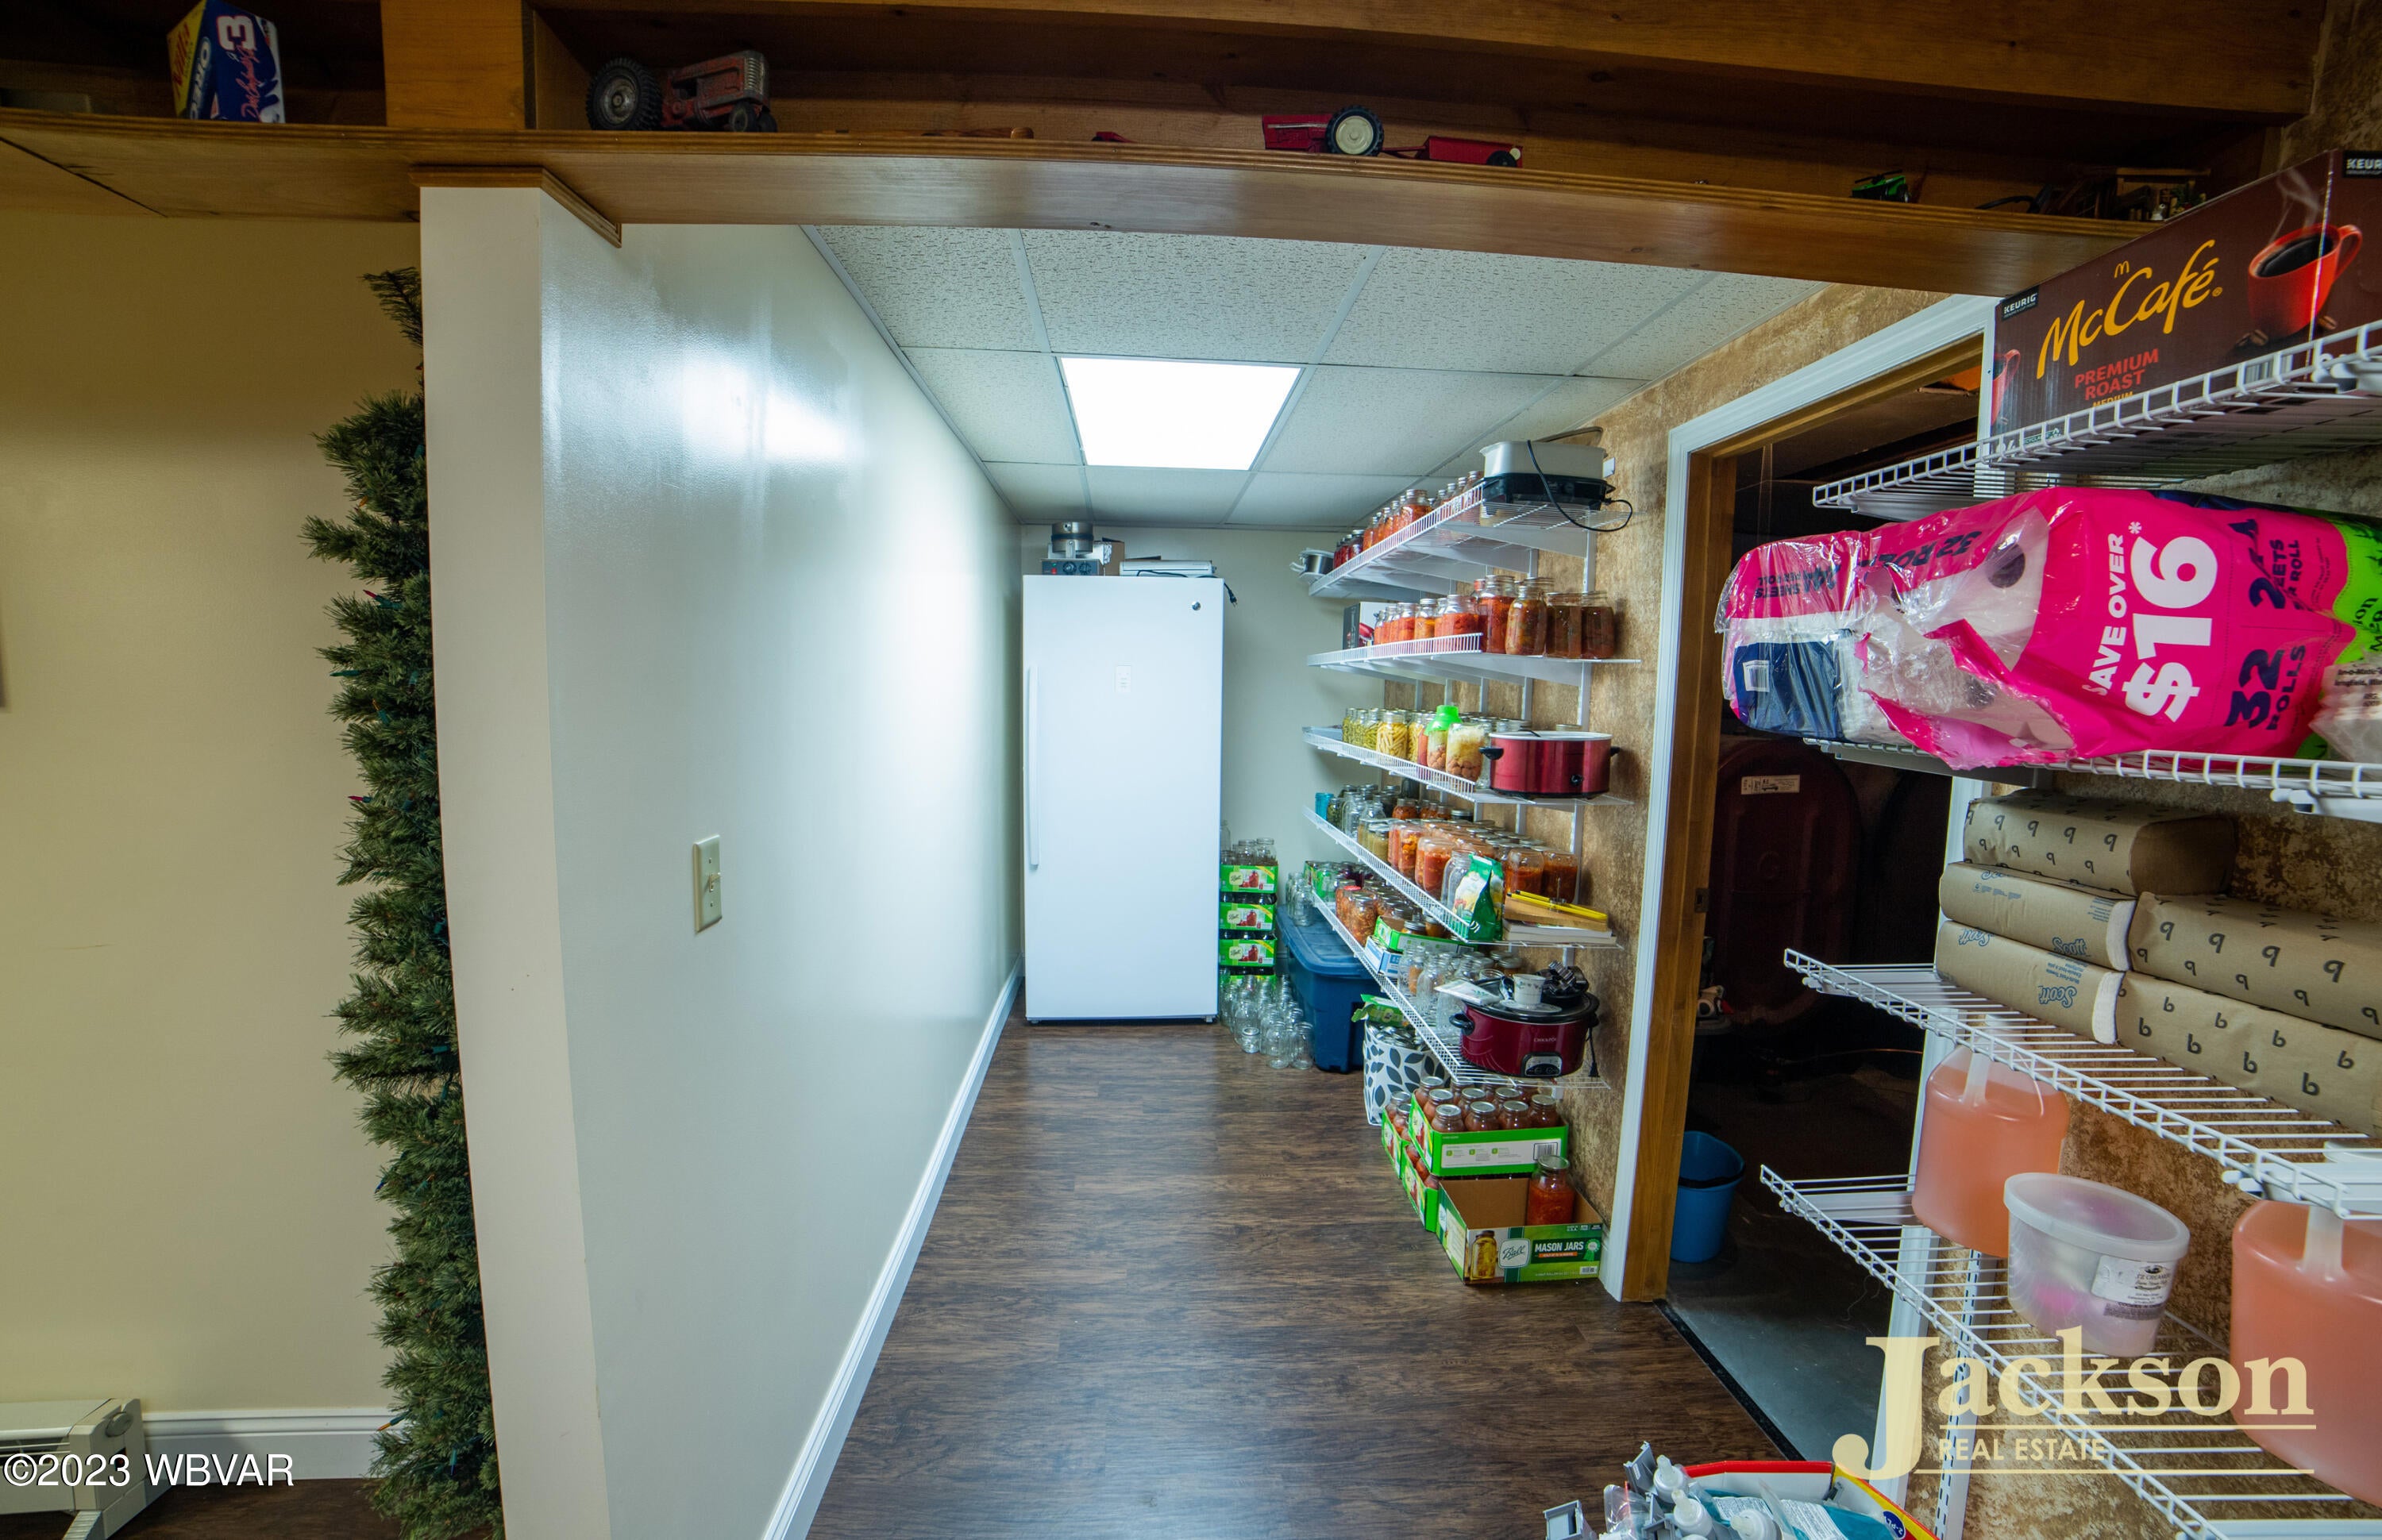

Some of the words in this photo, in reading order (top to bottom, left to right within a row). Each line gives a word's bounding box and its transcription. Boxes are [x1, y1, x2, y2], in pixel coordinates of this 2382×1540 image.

[217, 15, 256, 51] 3
[2003, 292, 2038, 314] KEURIG
[2037, 239, 2220, 379] McCafé
[2074, 348, 2159, 389] PREMIUM
[2085, 369, 2145, 401] ROAST
[2288, 540, 2304, 582] ROLL
[2082, 619, 2127, 697] SAVE
[2108, 533, 2127, 618] OVER
[2225, 649, 2286, 728] 32
[2265, 644, 2307, 731] ROLLS
[2038, 985, 2077, 1008] Scott
[1502, 1245, 1526, 1261] Ball
[1535, 1242, 1562, 1253] MASON
[1564, 1241, 1584, 1251] JARS
